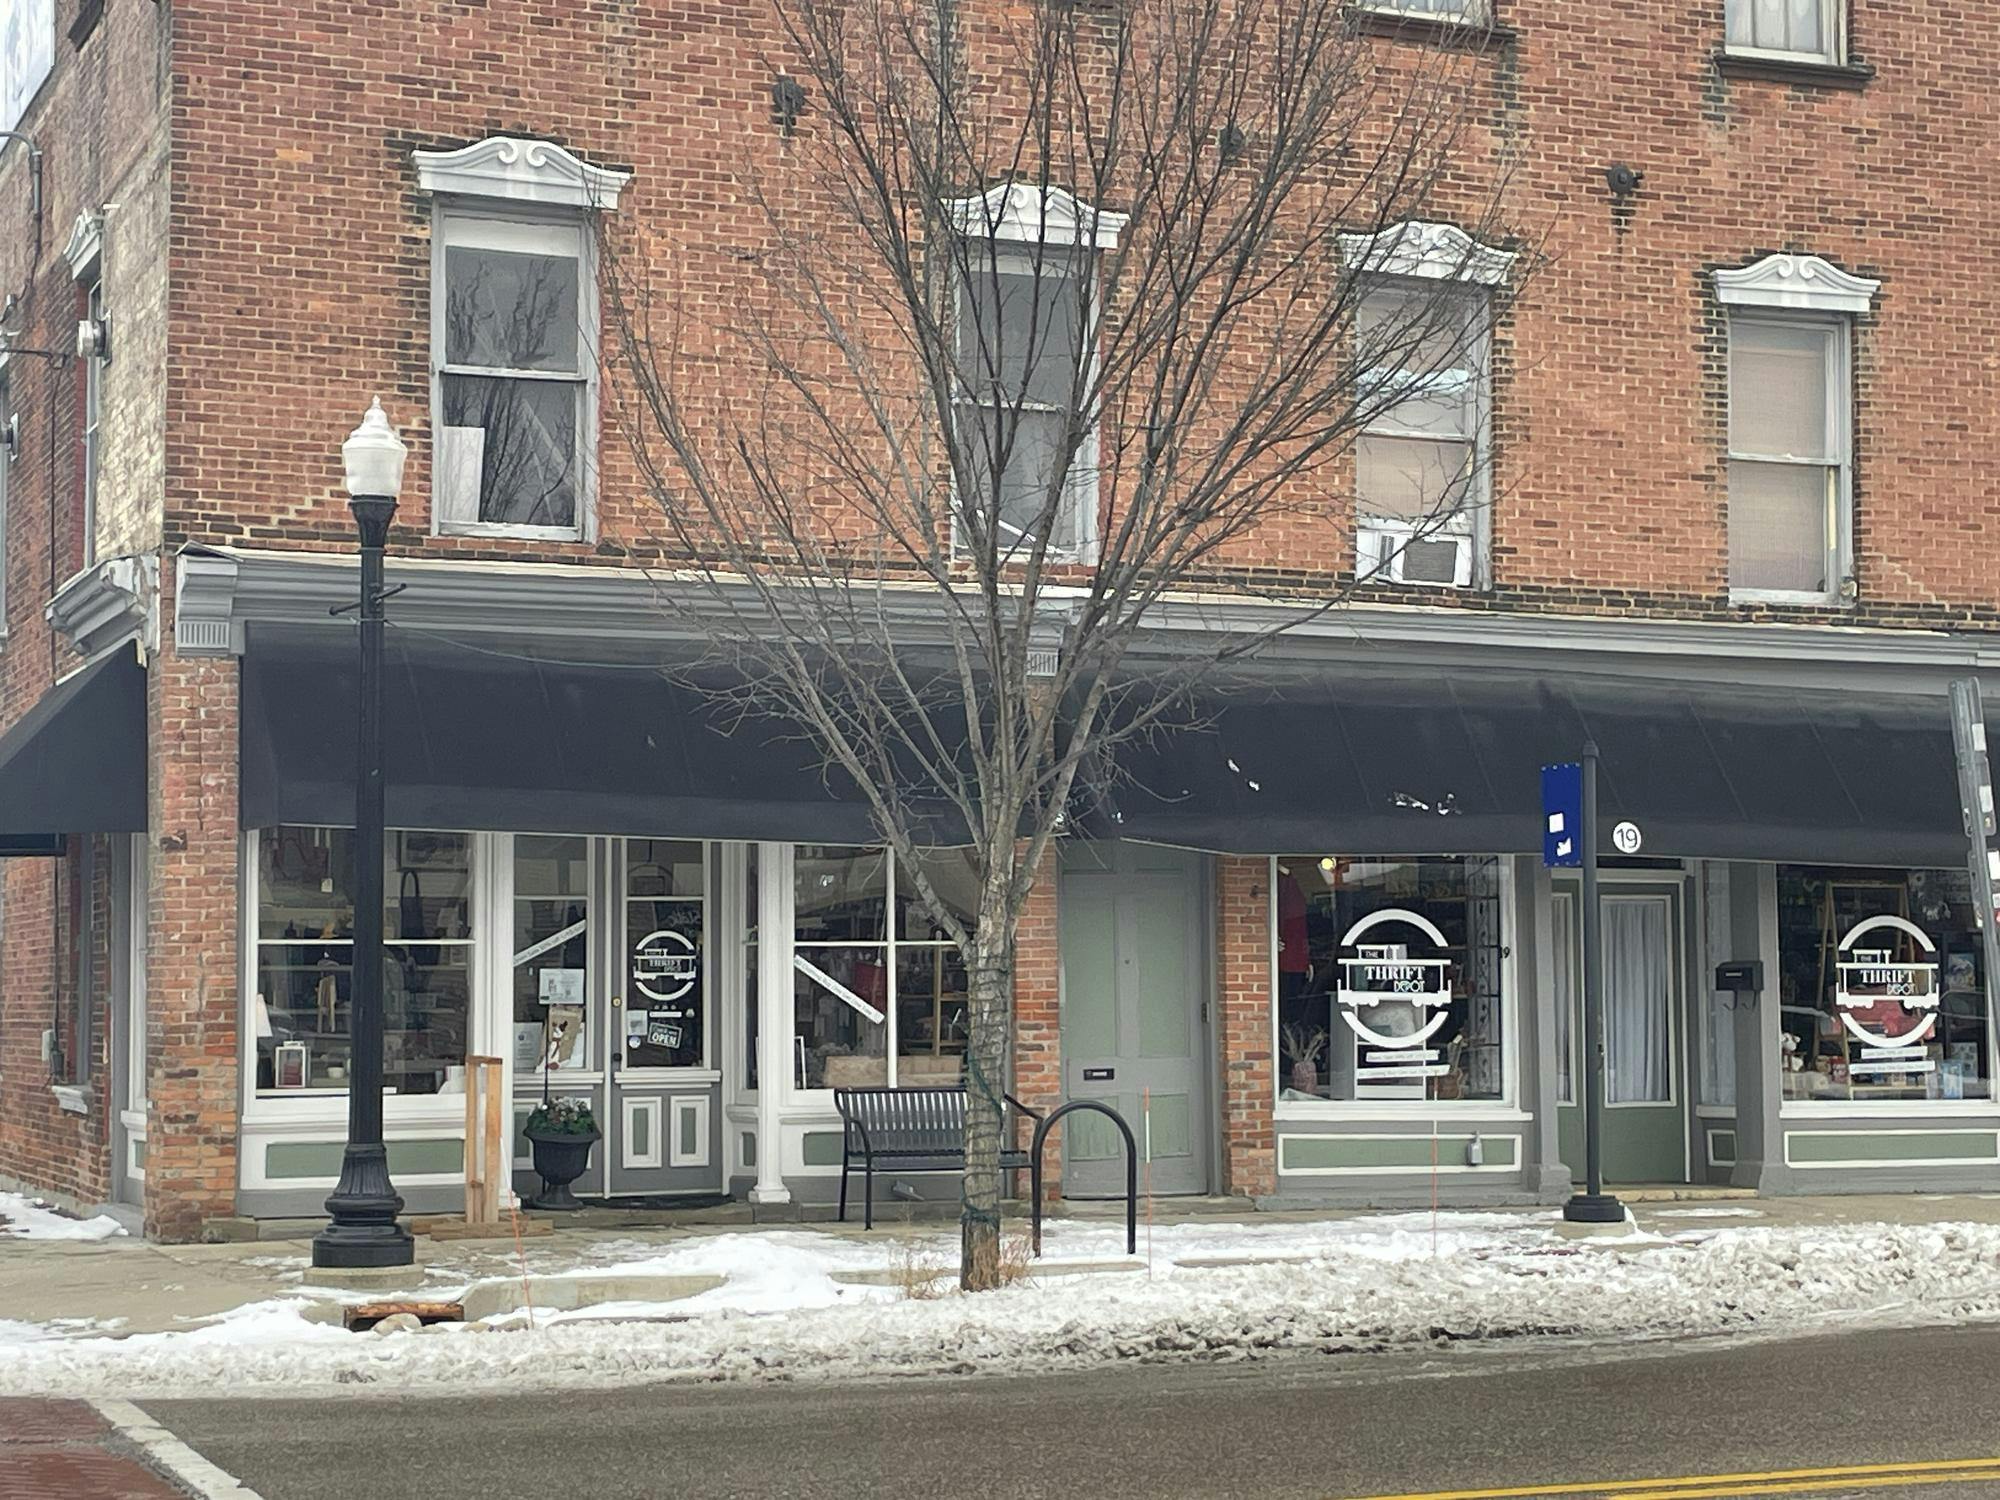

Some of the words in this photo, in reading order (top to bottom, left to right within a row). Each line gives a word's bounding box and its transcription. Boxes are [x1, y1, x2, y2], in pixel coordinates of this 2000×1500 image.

[1616, 828, 1638, 849] 19
[1364, 966, 1426, 981] THRIFT
[1860, 969, 1915, 984] THRIFT
[651, 1031, 677, 1046] OPEN
